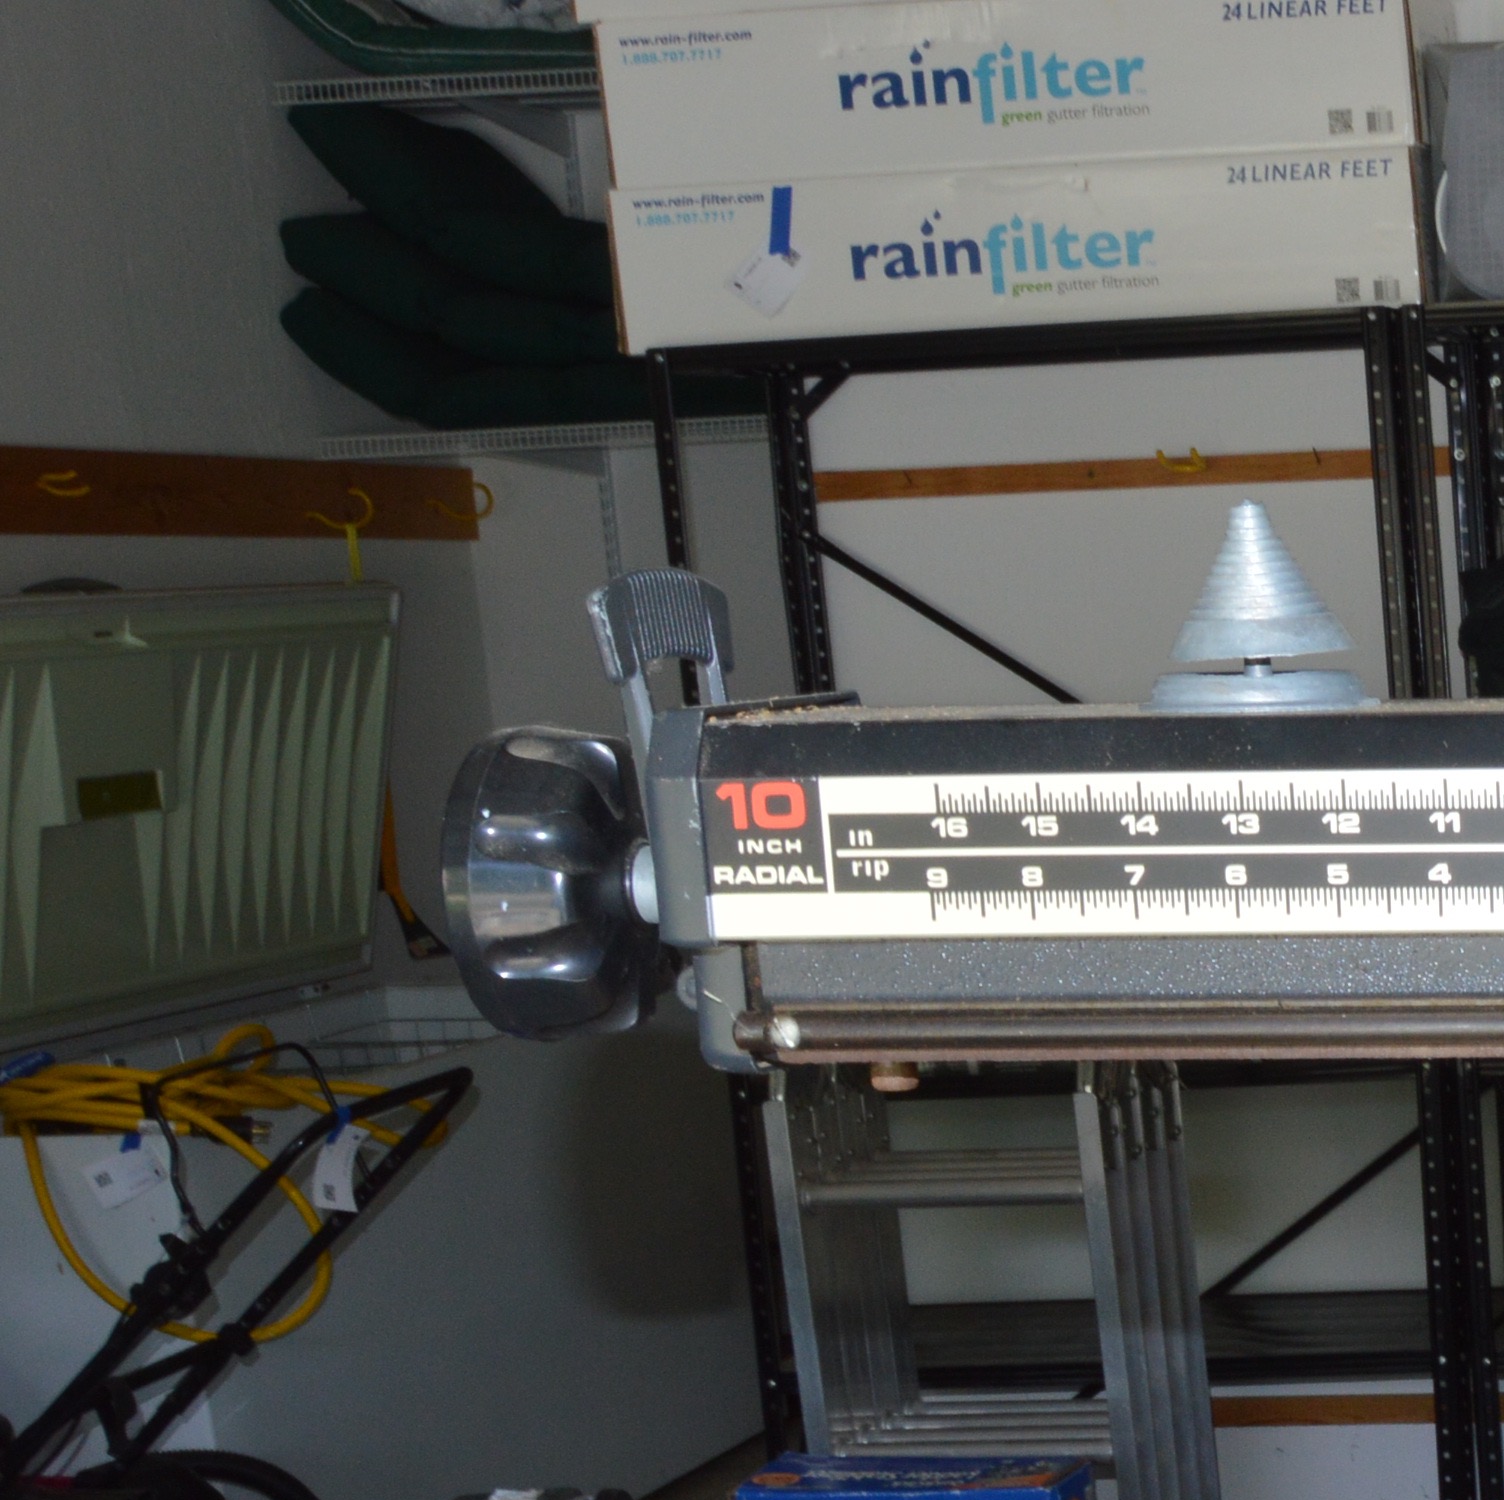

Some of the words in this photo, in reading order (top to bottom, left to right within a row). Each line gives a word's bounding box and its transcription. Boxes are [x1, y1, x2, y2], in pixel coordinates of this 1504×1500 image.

[1223, 1, 1243, 21] 24
[1246, 0, 1327, 20] LINEAR
[1336, 0, 1387, 16] FEET
[619, 28, 752, 49] www.rain-filter.com
[622, 48, 722, 65] 1.888.707.7717
[838, 41, 1145, 124] rainfilter
[1001, 107, 1042, 126] green
[1047, 105, 1088, 124] gutter
[1091, 102, 1150, 120] filtration
[1226, 165, 1247, 186] 24
[1253, 160, 1331, 183] LINEAR
[1341, 158, 1392, 177] FEET
[632, 191, 764, 212] www.rain-filter.com
[635, 210, 735, 226] 1.888.707.7717
[850, 210, 1155, 295] rainfilter
[1011, 280, 1053, 297] green
[1056, 277, 1098, 295] gutter
[1101, 273, 1159, 290] filtration
[716, 781, 807, 830] 10
[931, 816, 968, 838] 16
[1021, 815, 1058, 837] 15
[1121, 814, 1159, 836] 14
[1222, 813, 1260, 835] 13
[1322, 811, 1361, 834] 12
[1429, 811, 1461, 833] 11
[737, 839, 802, 854] INCH
[849, 827, 873, 847] in
[714, 865, 823, 885] RADIAL
[852, 857, 889, 880] rip
[926, 867, 948, 889] 9
[1022, 866, 1044, 888] 8
[1123, 865, 1145, 885] 7
[1225, 864, 1247, 885] 6
[1327, 863, 1349, 885] 5
[1428, 862, 1451, 884] 4
